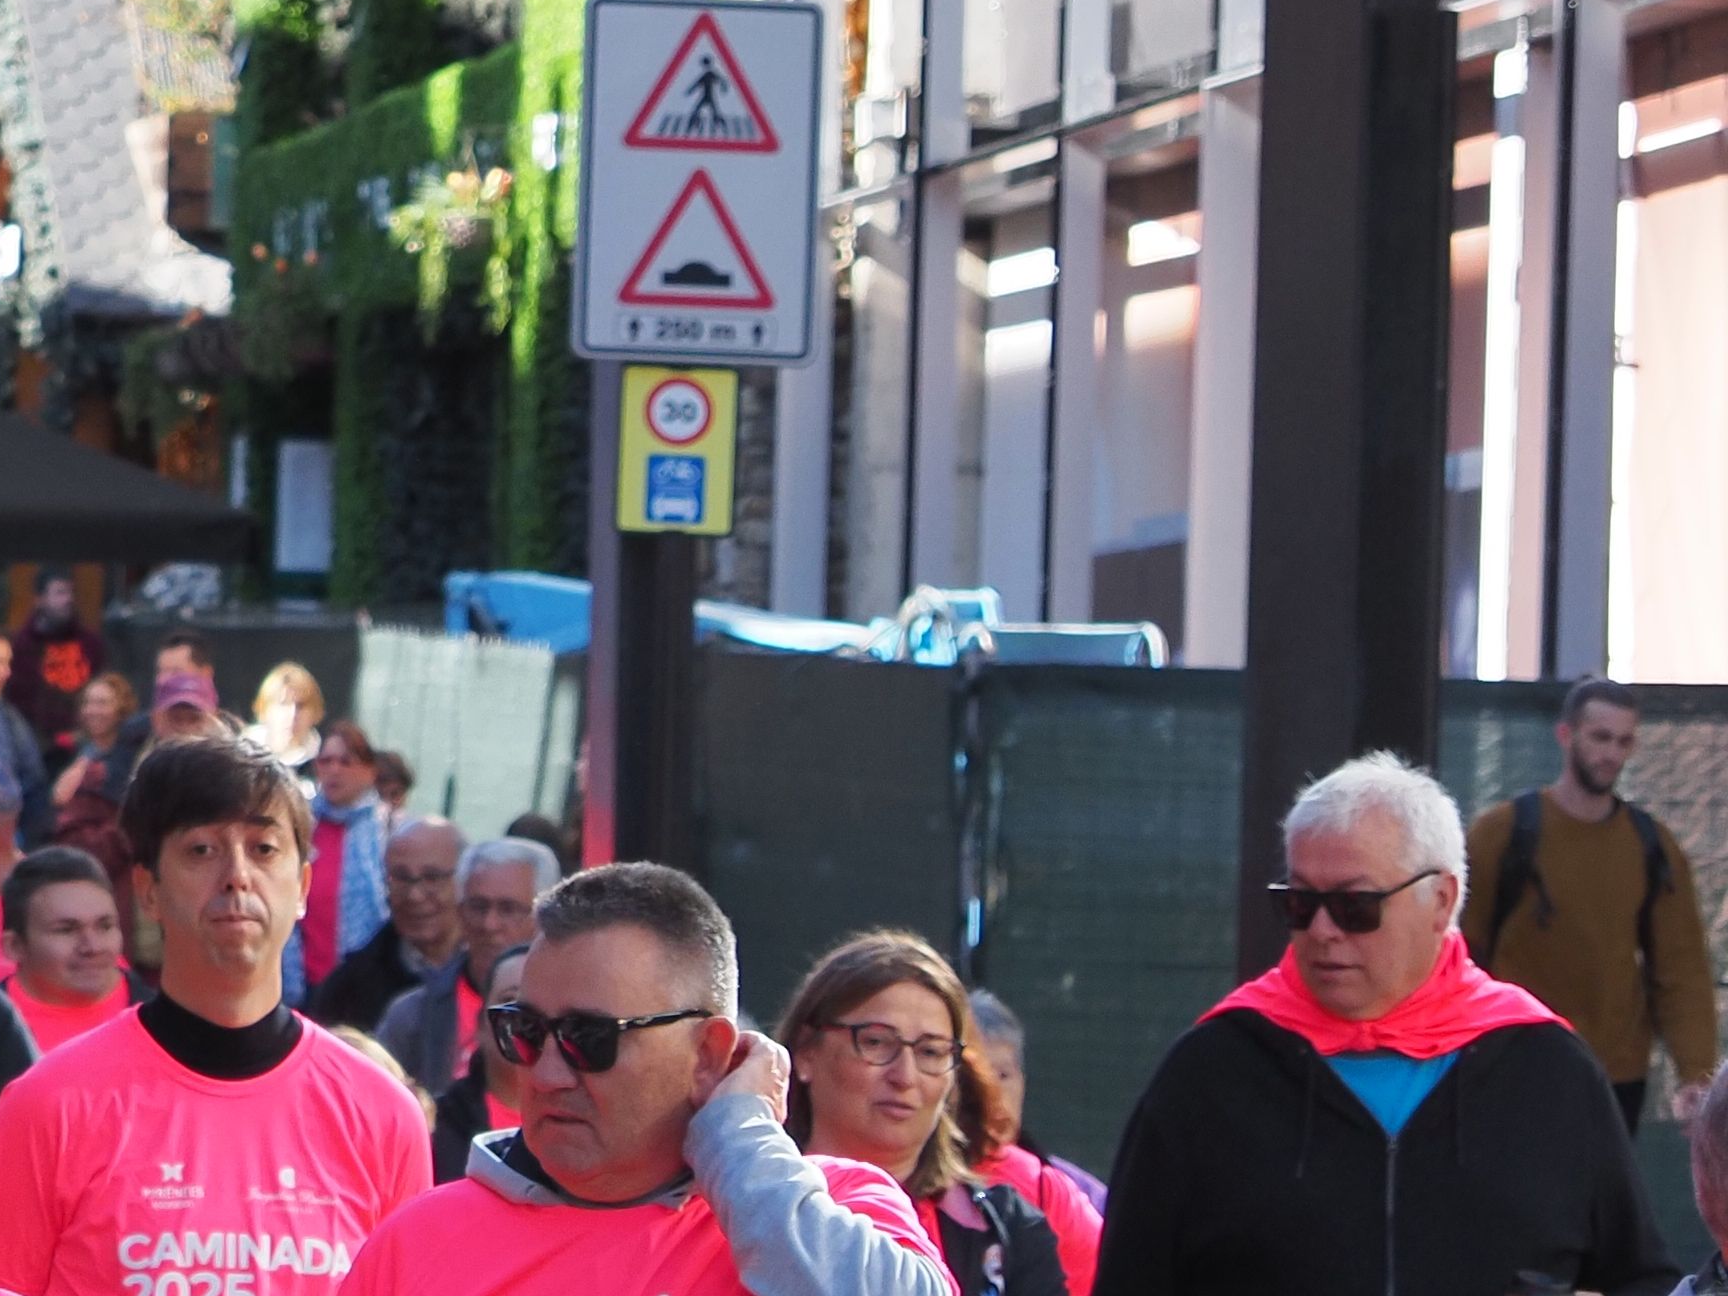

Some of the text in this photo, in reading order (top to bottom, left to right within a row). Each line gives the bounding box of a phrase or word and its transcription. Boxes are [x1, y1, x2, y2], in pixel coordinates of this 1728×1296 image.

[656, 320, 704, 341] 250
[661, 401, 697, 422] 30
[118, 1231, 353, 1278] CAMINADA
